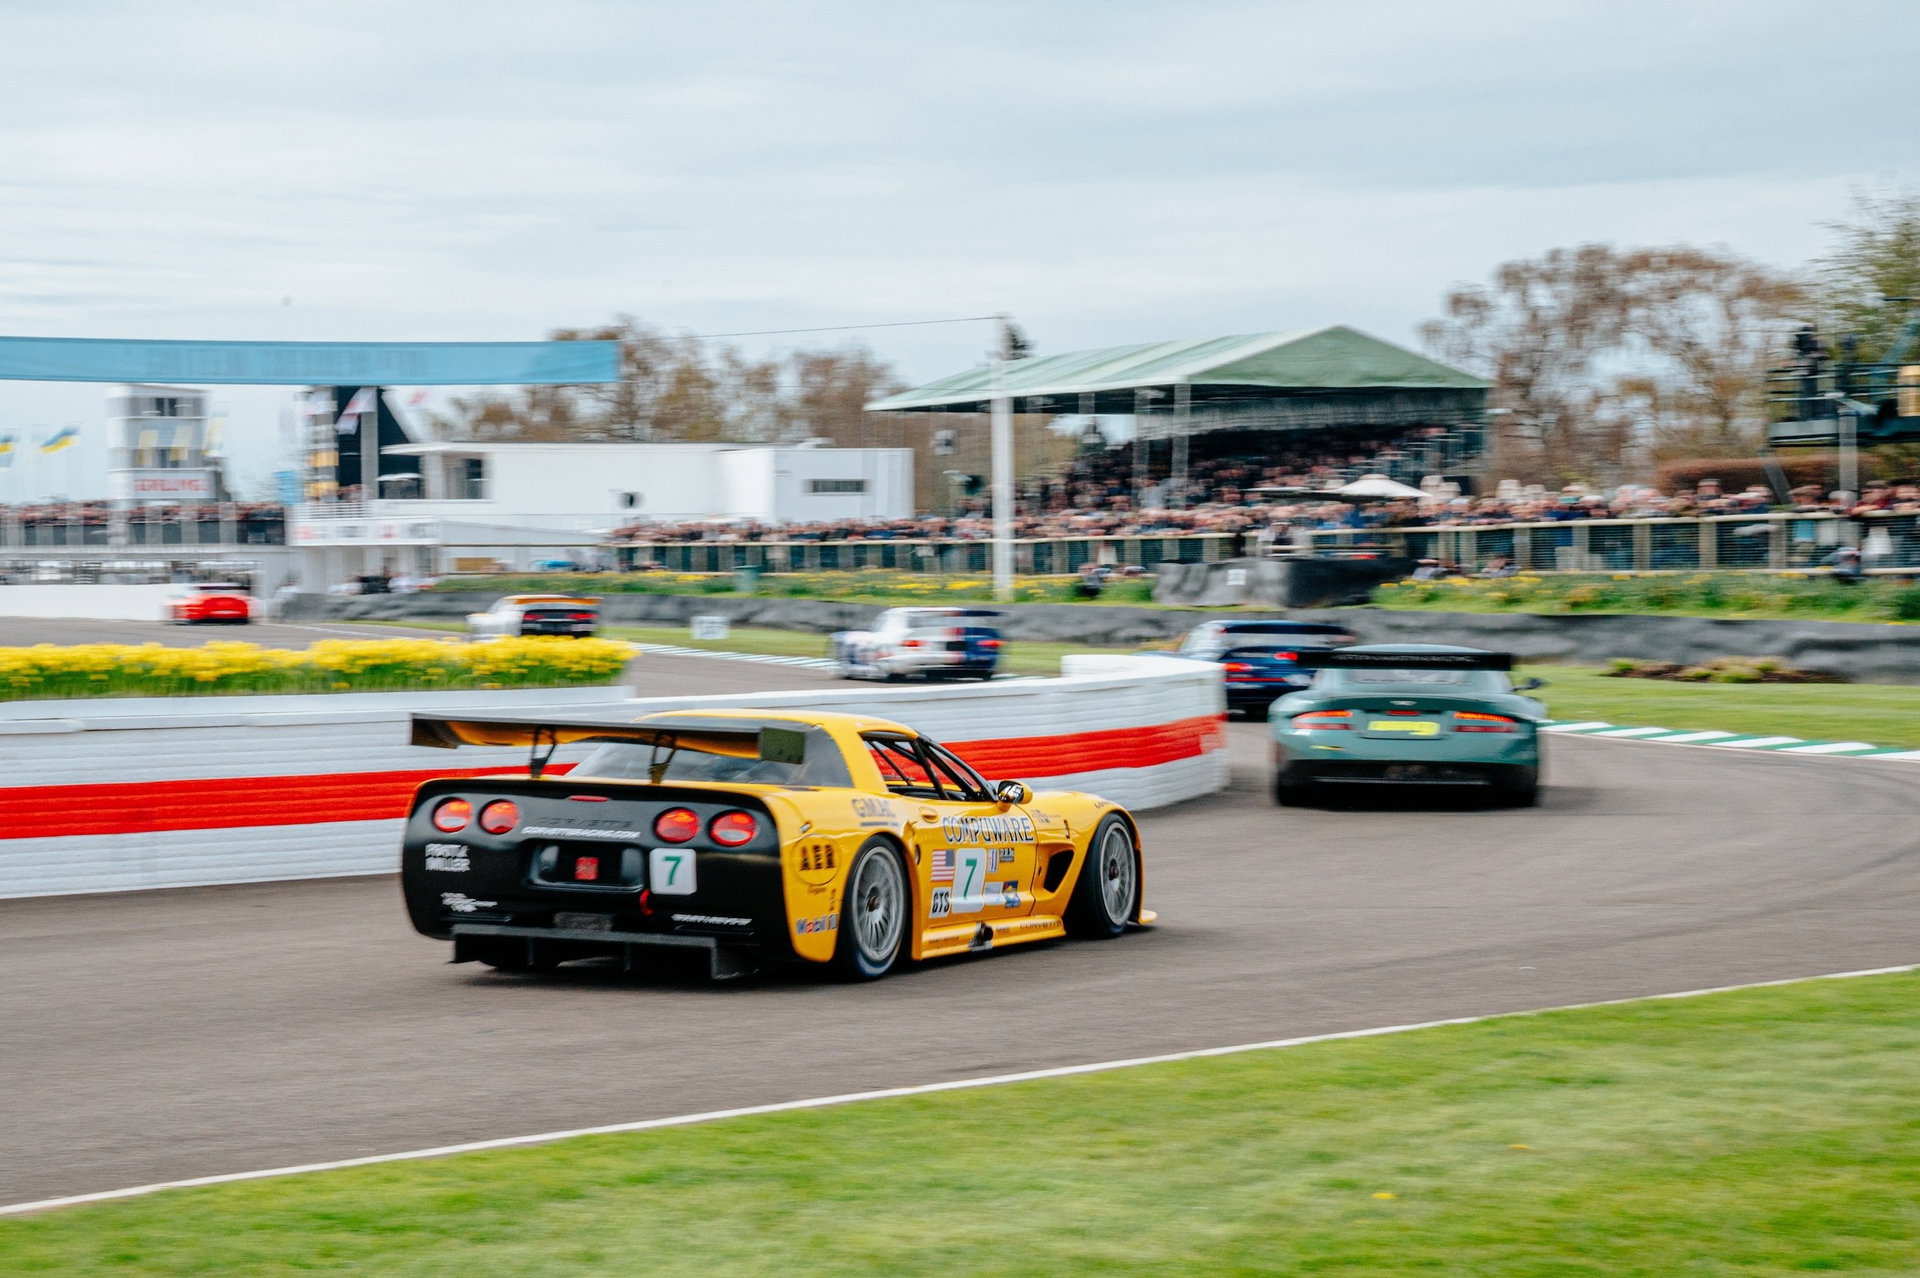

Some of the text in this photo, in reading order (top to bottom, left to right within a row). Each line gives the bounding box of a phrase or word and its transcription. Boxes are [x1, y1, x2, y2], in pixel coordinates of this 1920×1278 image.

[942, 815, 1034, 844] COMPUWARE
[663, 855, 683, 887] 7
[963, 858, 978, 901] 7
[931, 890, 950, 913] GTS
